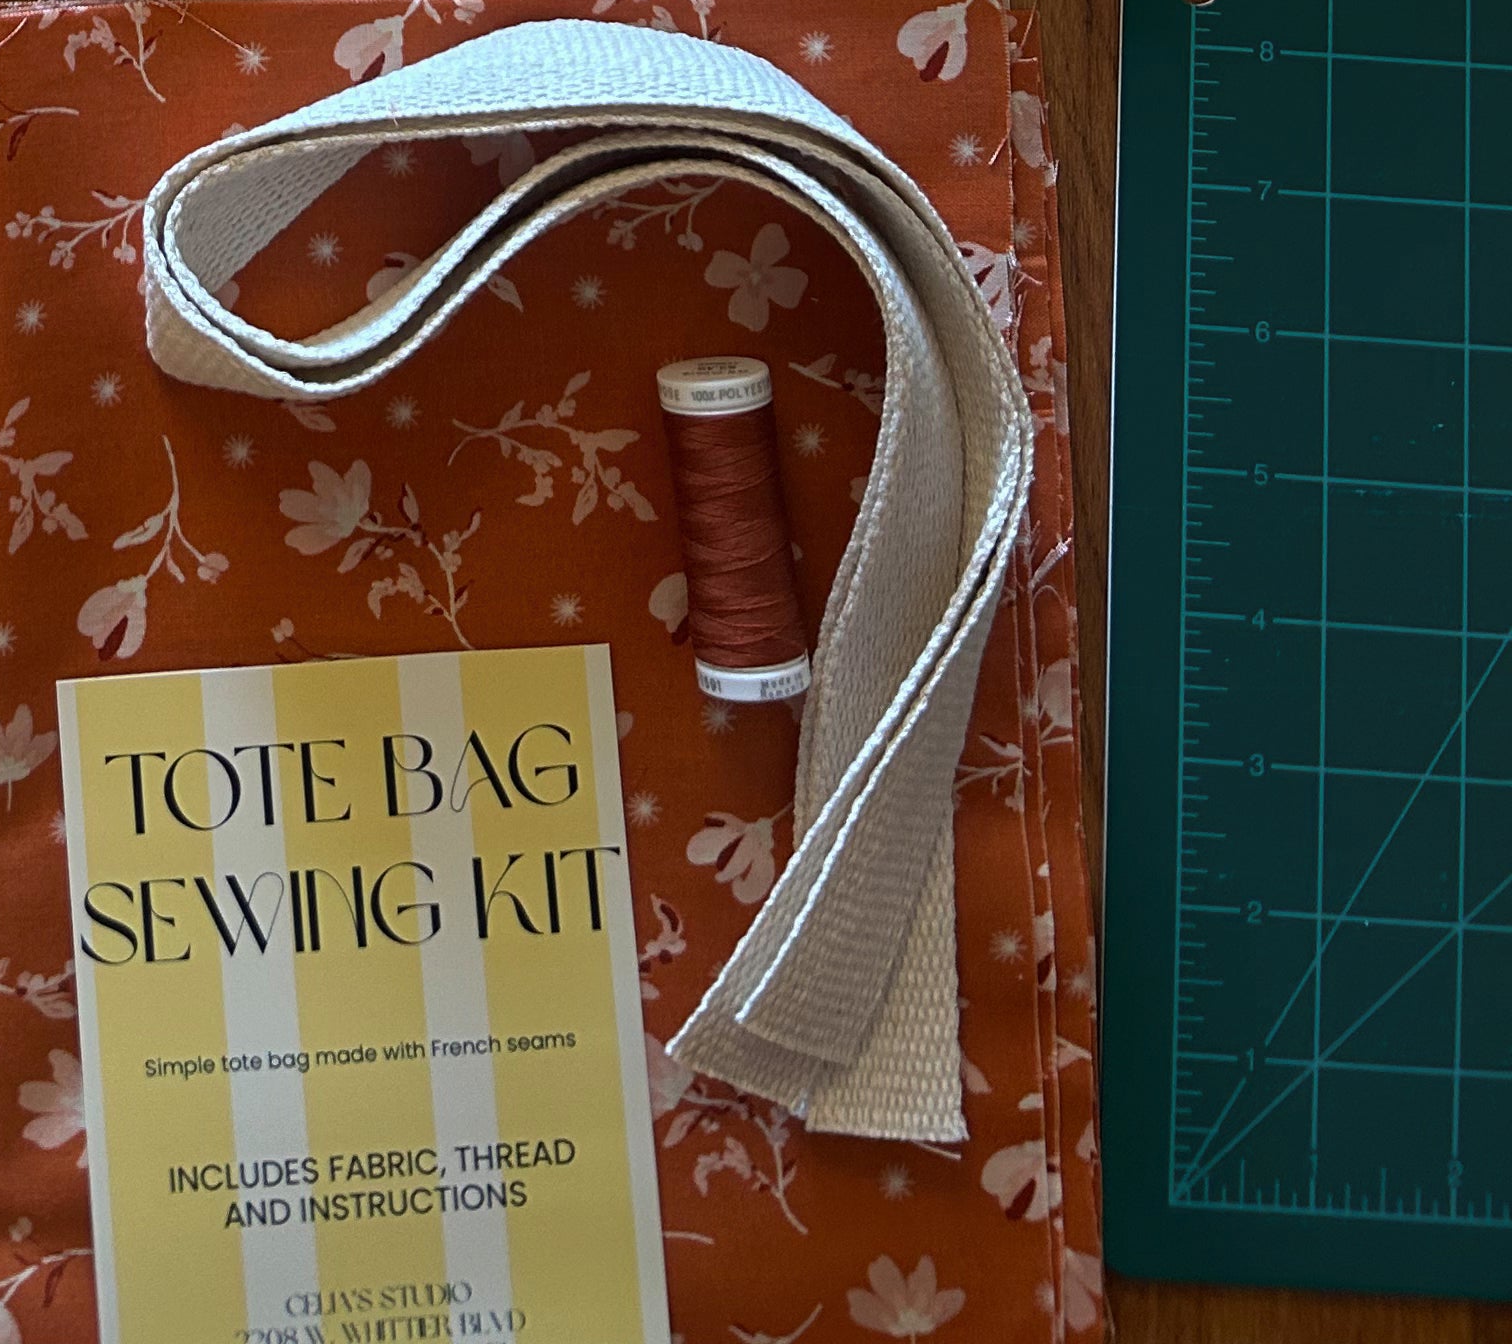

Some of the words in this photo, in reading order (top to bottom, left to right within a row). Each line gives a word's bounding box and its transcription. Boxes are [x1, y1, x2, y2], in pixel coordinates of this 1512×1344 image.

[1259, 40, 1274, 62] 8
[1257, 179, 1273, 201] 7
[1254, 320, 1271, 343] 6
[1253, 463, 1269, 486] 5
[1251, 608, 1266, 630] 4
[1249, 753, 1265, 777] 3
[104, 739, 351, 836] TOTE
[382, 723, 579, 818] BAG
[79, 861, 442, 965] SEWING
[471, 846, 621, 940] KIT
[1246, 900, 1263, 924] 2
[144, 1055, 216, 1081] Simple
[220, 1053, 263, 1073] tote
[267, 1050, 311, 1074] bag
[315, 1043, 378, 1067] made
[381, 1040, 426, 1061] with
[430, 1034, 502, 1057] French
[506, 1032, 577, 1054] seams
[1245, 1047, 1255, 1071] 1
[168, 1156, 320, 1194] INCLUDES
[328, 1147, 447, 1183] FABRIC,
[453, 1137, 576, 1173] THREAD
[224, 1197, 292, 1229] AND
[299, 1181, 528, 1223] INSTRUCTIONS
[459, 1309, 526, 1337] BLVD
